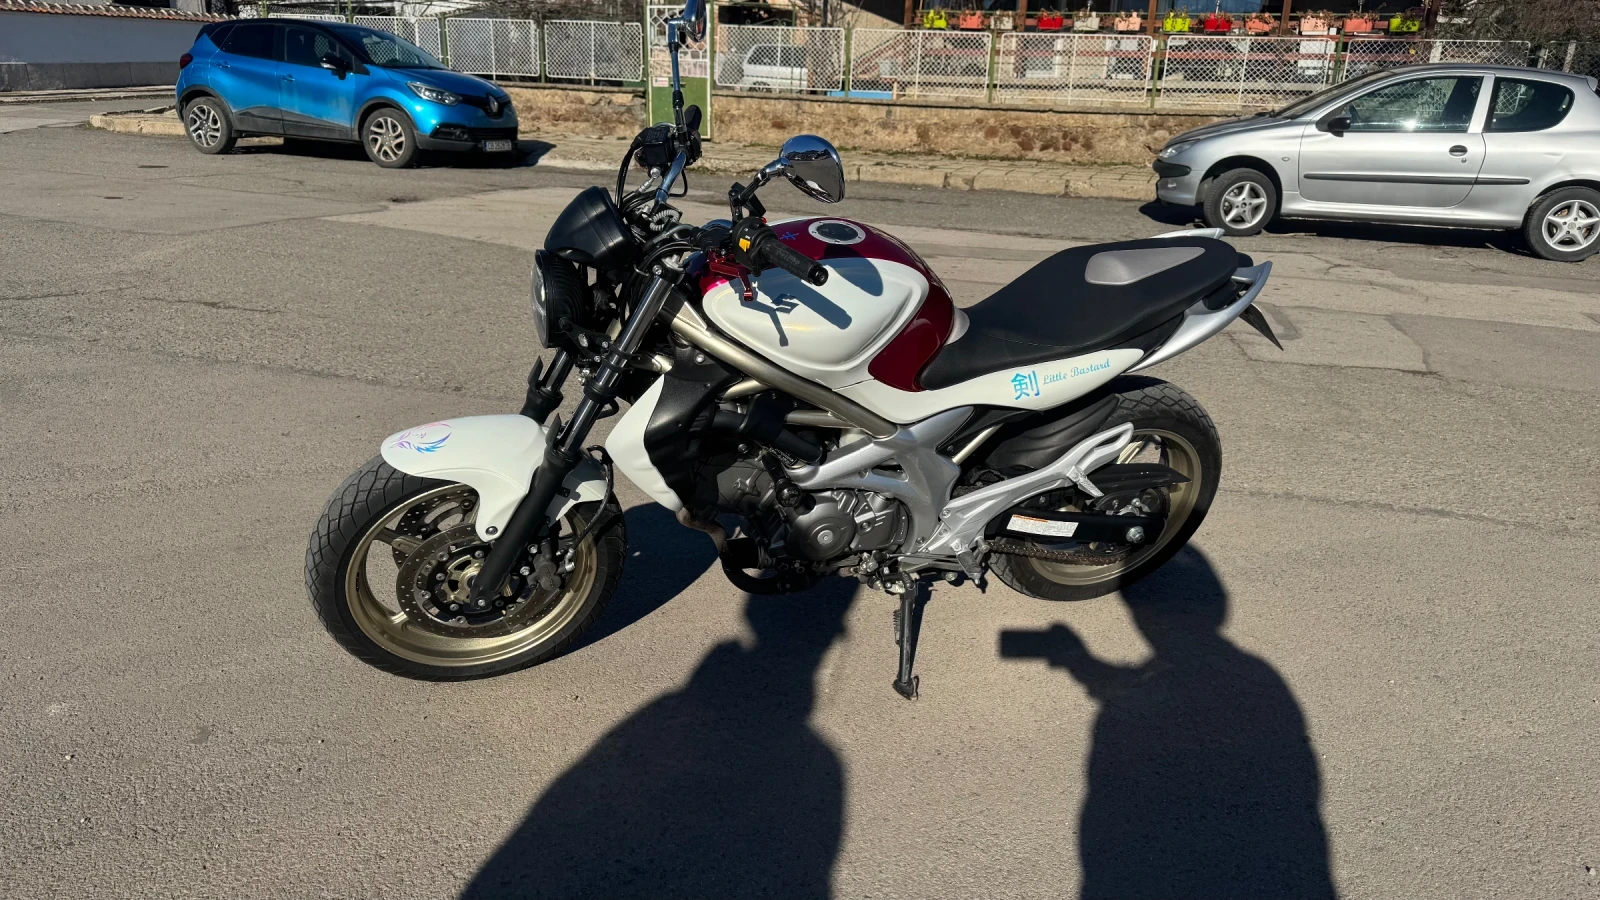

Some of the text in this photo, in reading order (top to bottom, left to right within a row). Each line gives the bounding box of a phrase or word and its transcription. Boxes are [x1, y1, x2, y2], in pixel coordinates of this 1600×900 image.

[1010, 370, 1040, 401] 剣
[1042, 358, 1111, 385] Little Bastard
